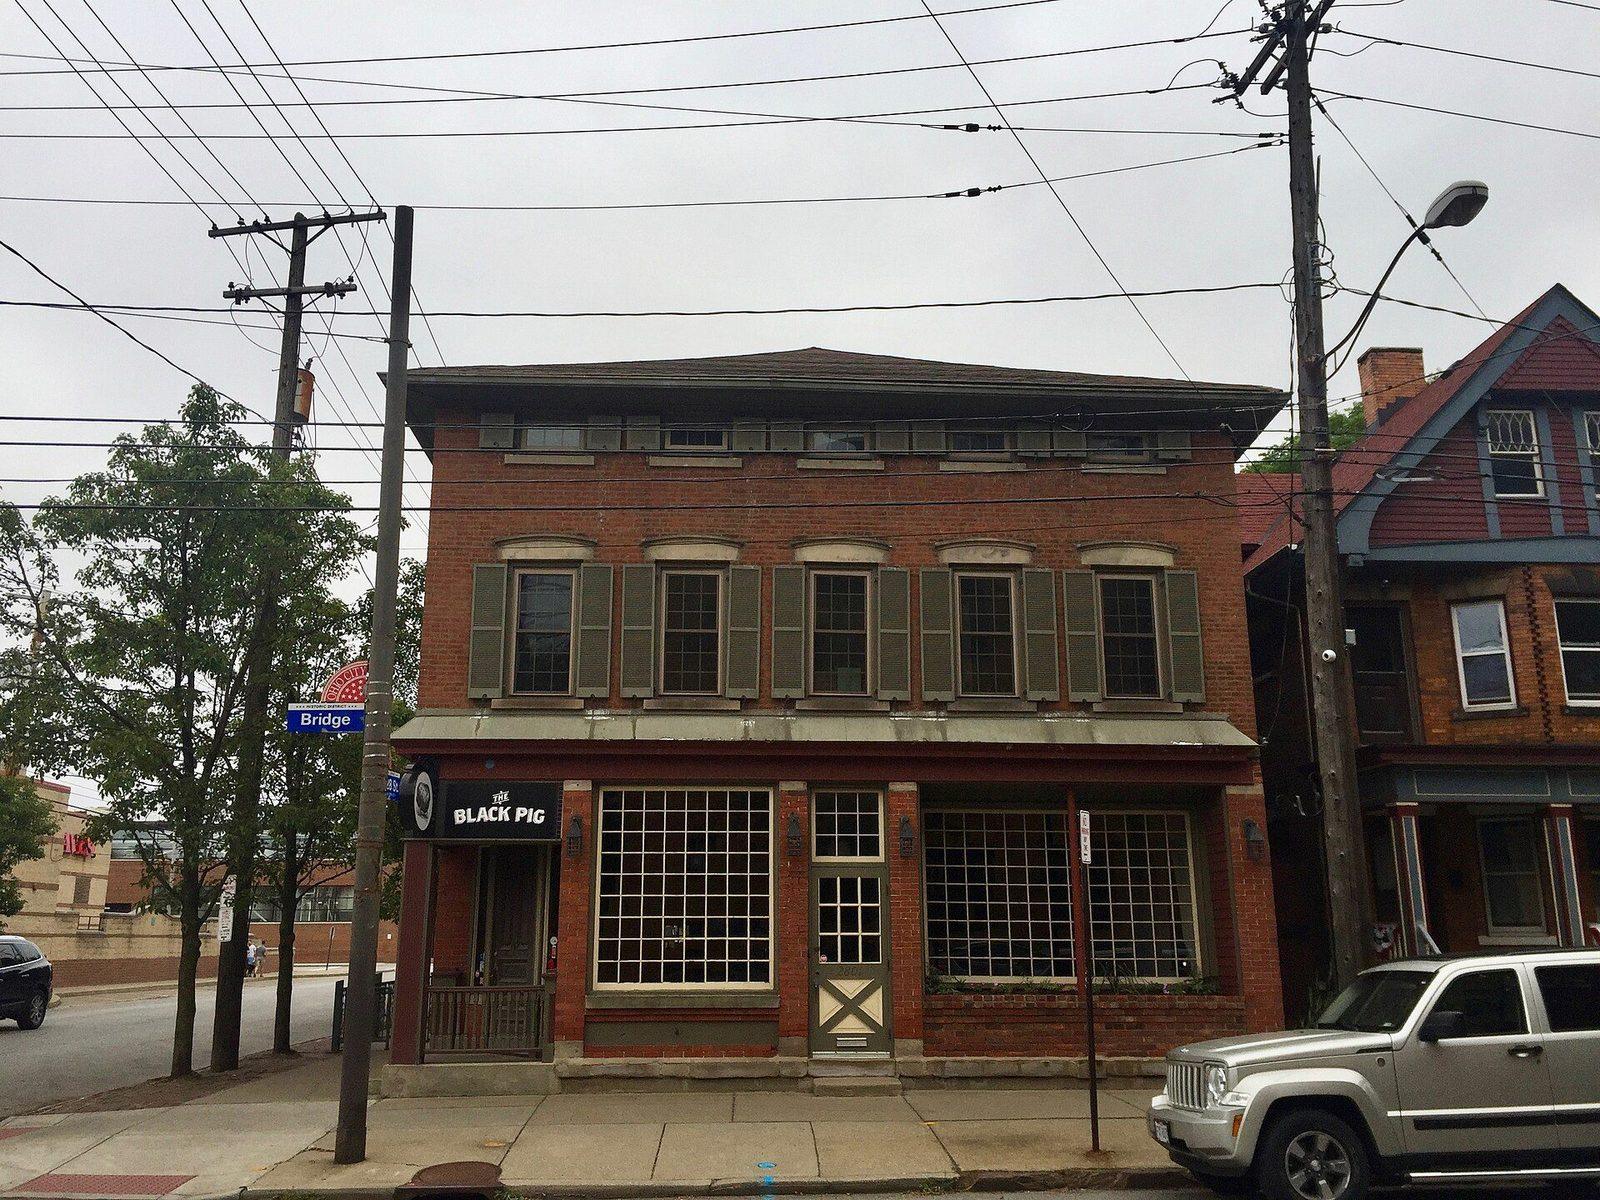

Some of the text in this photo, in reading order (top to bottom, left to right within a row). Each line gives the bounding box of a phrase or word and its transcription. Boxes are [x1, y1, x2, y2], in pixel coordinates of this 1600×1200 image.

[326, 665, 366, 701] OHIO CITY
[300, 712, 351, 729] Bridge
[492, 792, 510, 803] THE
[453, 806, 546, 825] BLACK PIG
